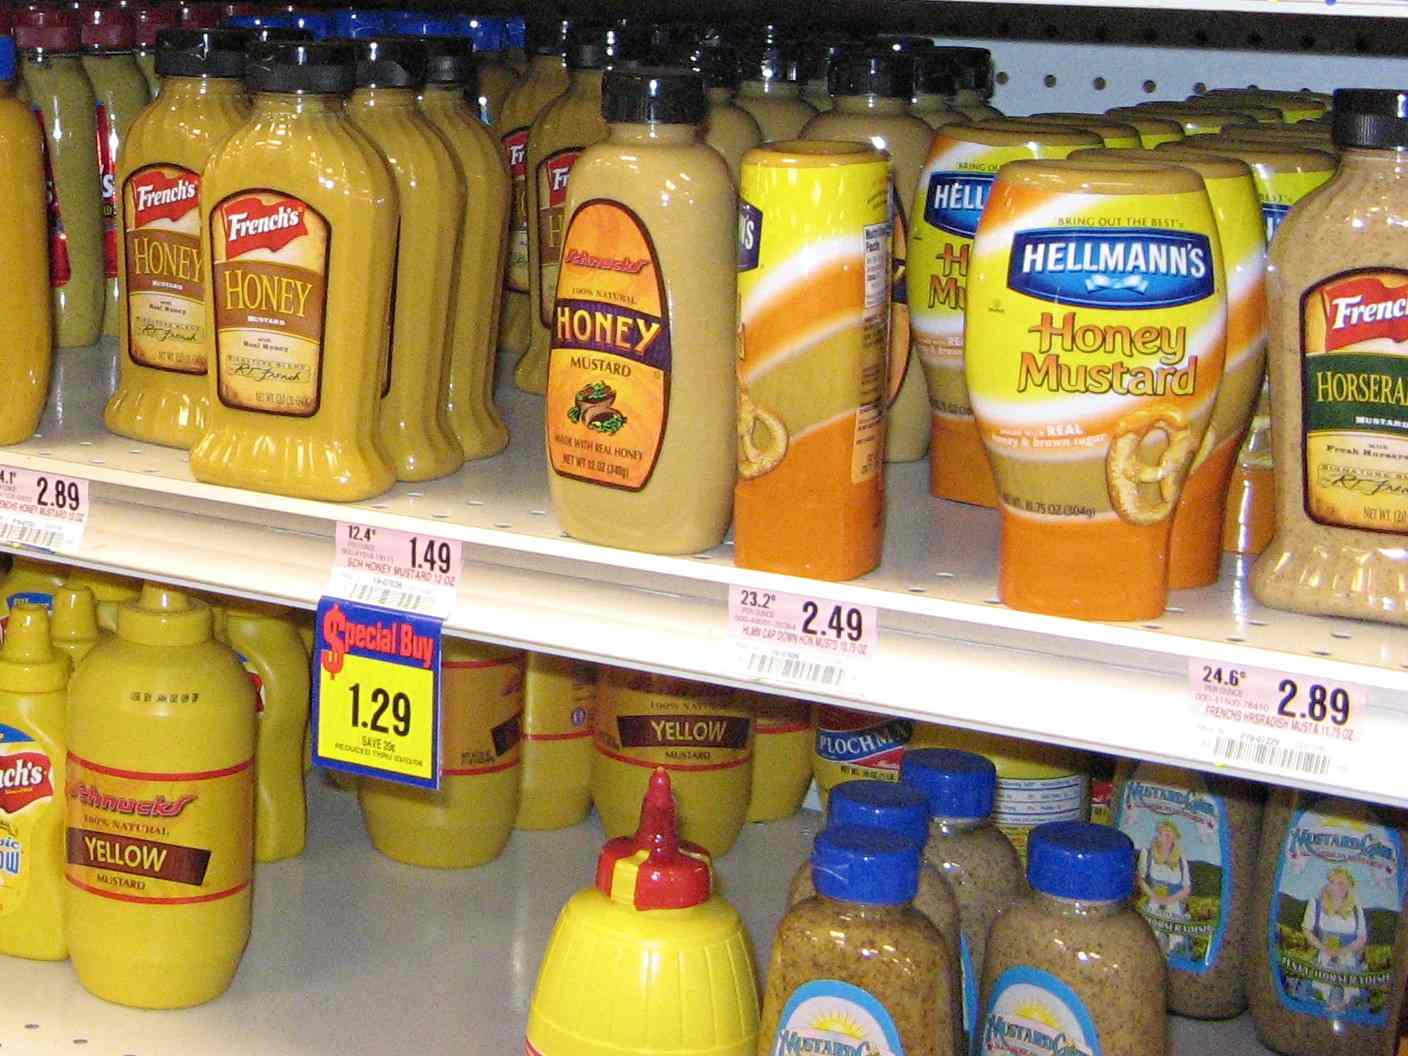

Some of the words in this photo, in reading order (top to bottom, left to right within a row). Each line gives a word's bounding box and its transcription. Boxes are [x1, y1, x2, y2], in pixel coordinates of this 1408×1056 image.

[137, 180, 196, 213] French's
[228, 207, 300, 242] French's
[1058, 217, 1095, 228] BRING
[1098, 217, 1122, 227] OUT
[1127, 217, 1146, 227] THE
[134, 238, 201, 283] HONEY
[1022, 242, 1207, 278] HELLMANN'S
[223, 270, 313, 318] HONEY
[557, 306, 661, 355] HONEY
[1028, 311, 1187, 360] Honey
[570, 355, 632, 378] MUSTARD
[1017, 351, 1199, 397] Mustard
[36, 476, 80, 511] 2.89
[409, 537, 450, 574] 1.49
[802, 601, 862, 642] 2.49
[400, 624, 434, 669] Buy
[349, 683, 412, 736] 1.29
[1277, 679, 1350, 725] 2.89
[650, 719, 726, 743] YELLOW
[85, 836, 167, 872] YELLOW
[96, 872, 146, 891] MUSTARD
